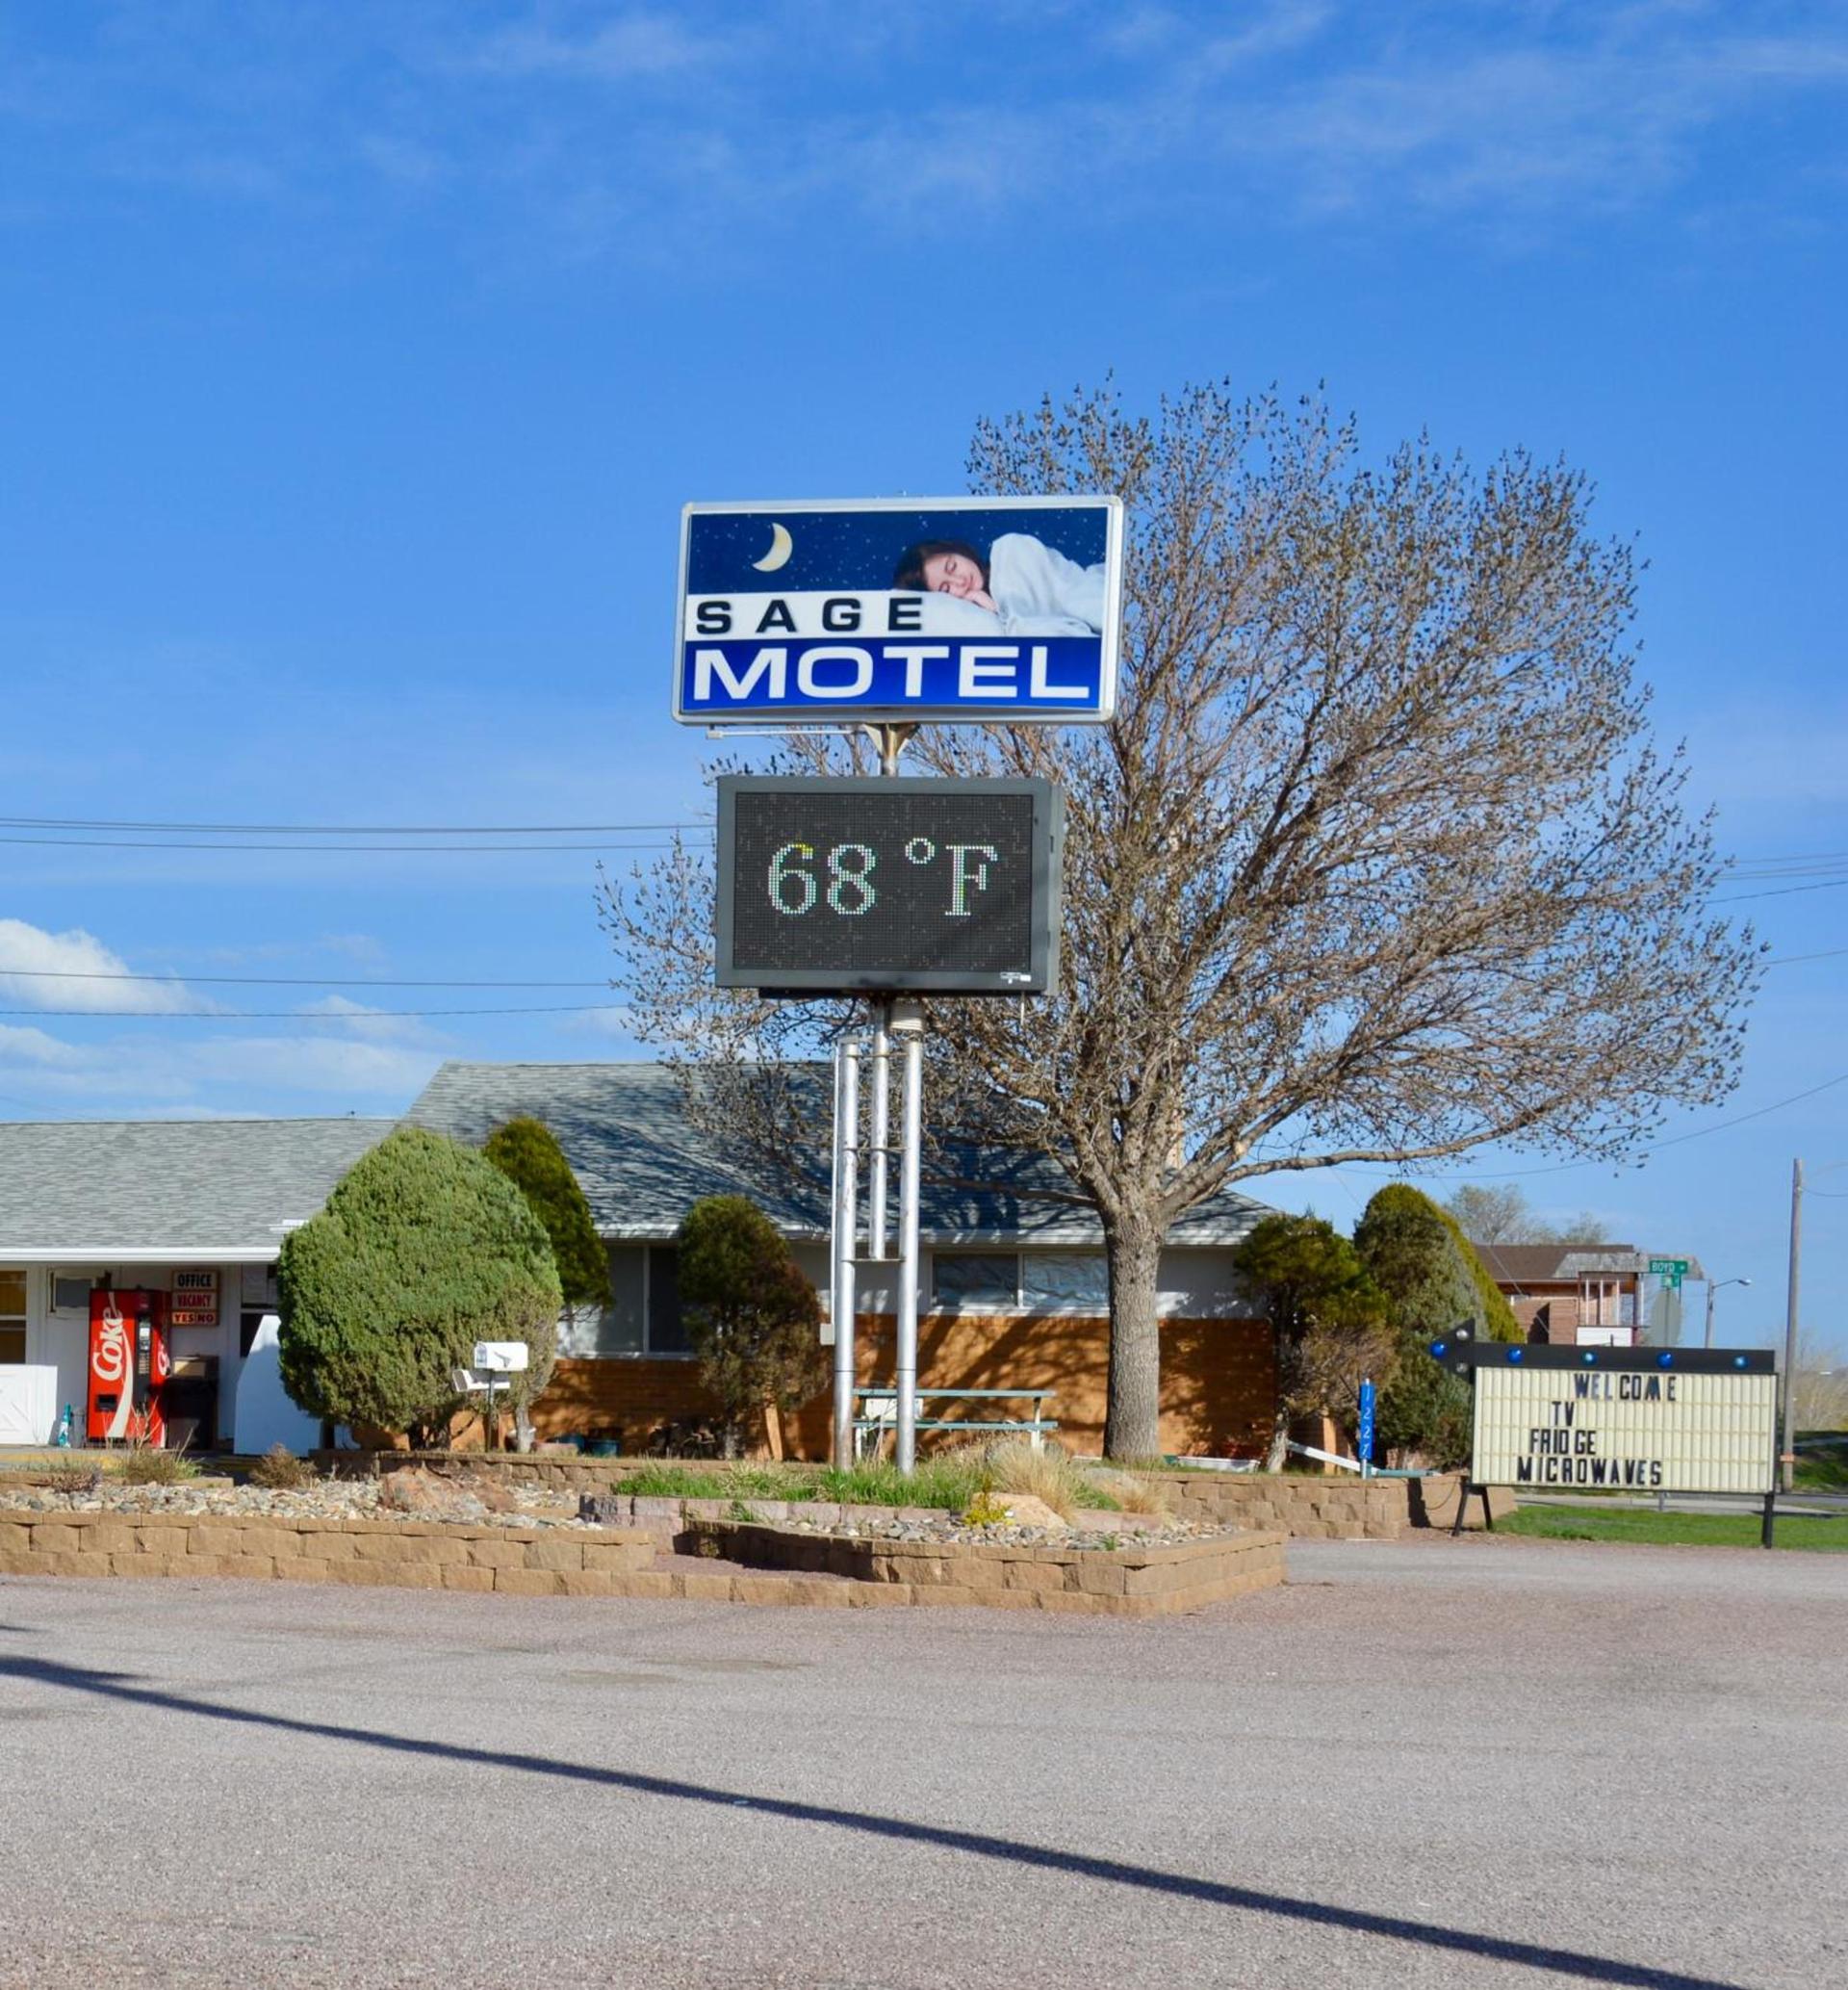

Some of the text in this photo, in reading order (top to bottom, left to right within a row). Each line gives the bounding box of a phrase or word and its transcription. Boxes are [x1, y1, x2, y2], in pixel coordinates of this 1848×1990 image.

[695, 596, 924, 634] SAGE
[693, 645, 1091, 701] MOTEL
[768, 842, 877, 916] 68
[177, 1273, 212, 1287] OFFICE
[1651, 1262, 1675, 1273] BOYD
[177, 1293, 212, 1307] VACANCY
[174, 1312, 214, 1323] YES NO
[92, 1305, 123, 1382] Coke
[1574, 1373, 1677, 1402] WELCOME
[1552, 1401, 1575, 1427] TV
[1529, 1428, 1597, 1455] FRIDGE
[1517, 1456, 1662, 1486] MICROWAVES
